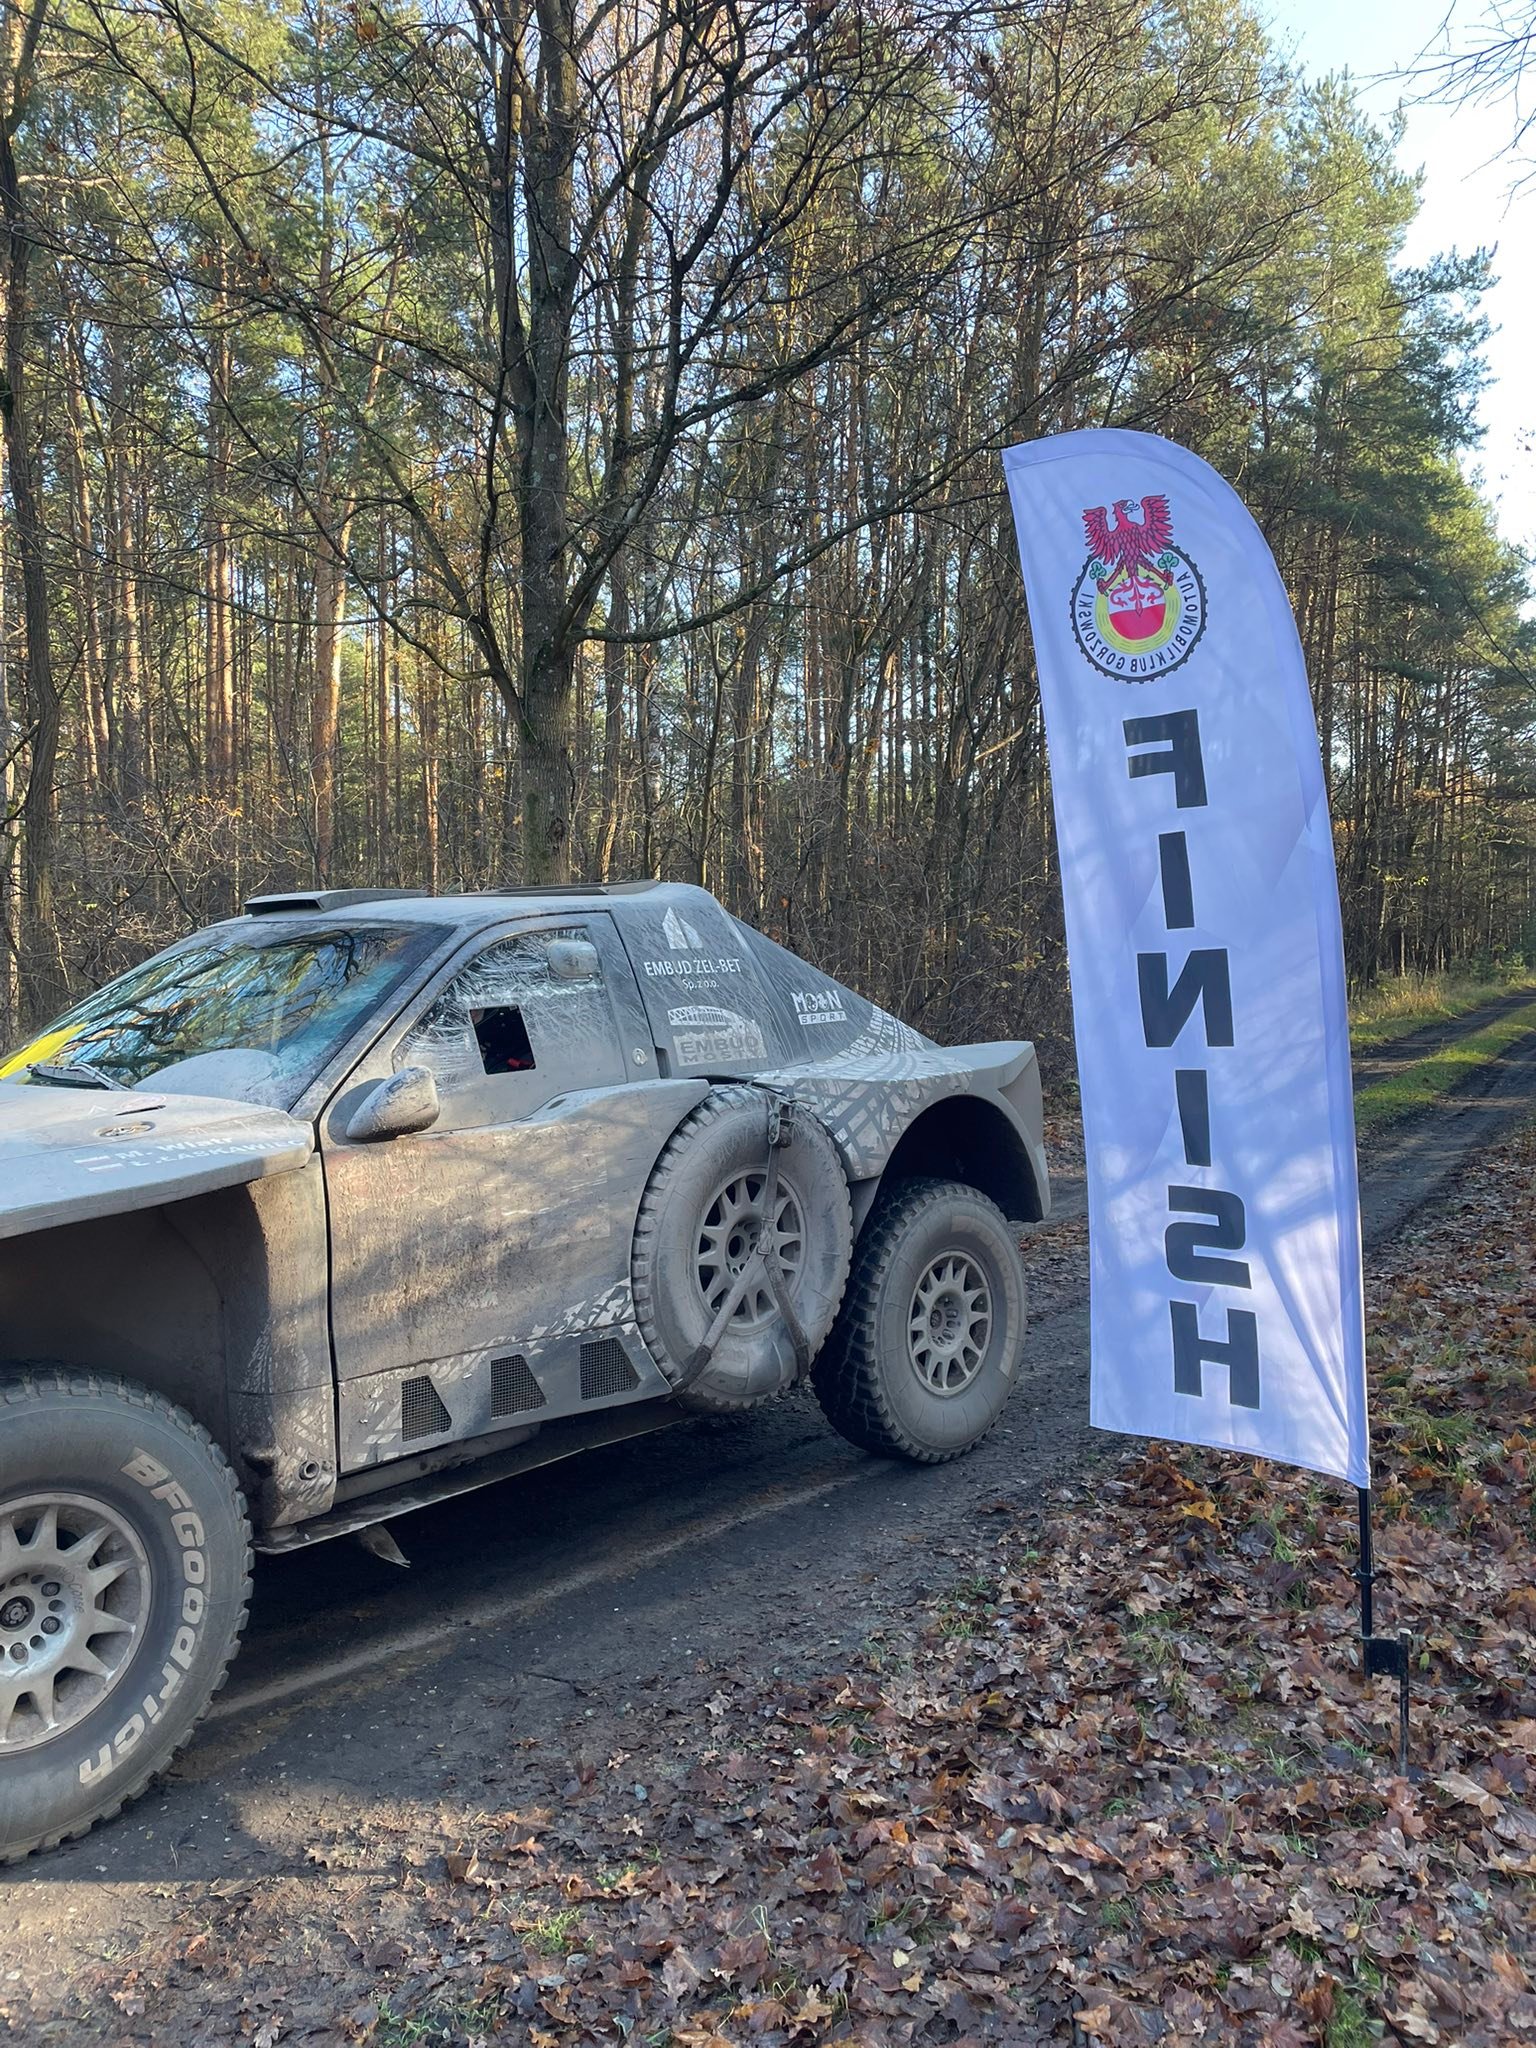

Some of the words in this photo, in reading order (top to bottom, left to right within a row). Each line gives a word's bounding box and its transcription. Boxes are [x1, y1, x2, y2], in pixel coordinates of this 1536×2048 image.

[643, 960, 692, 976] EMBUD
[801, 1012, 844, 1024] SPORT
[79, 1446, 206, 1785] BFGoodrich
